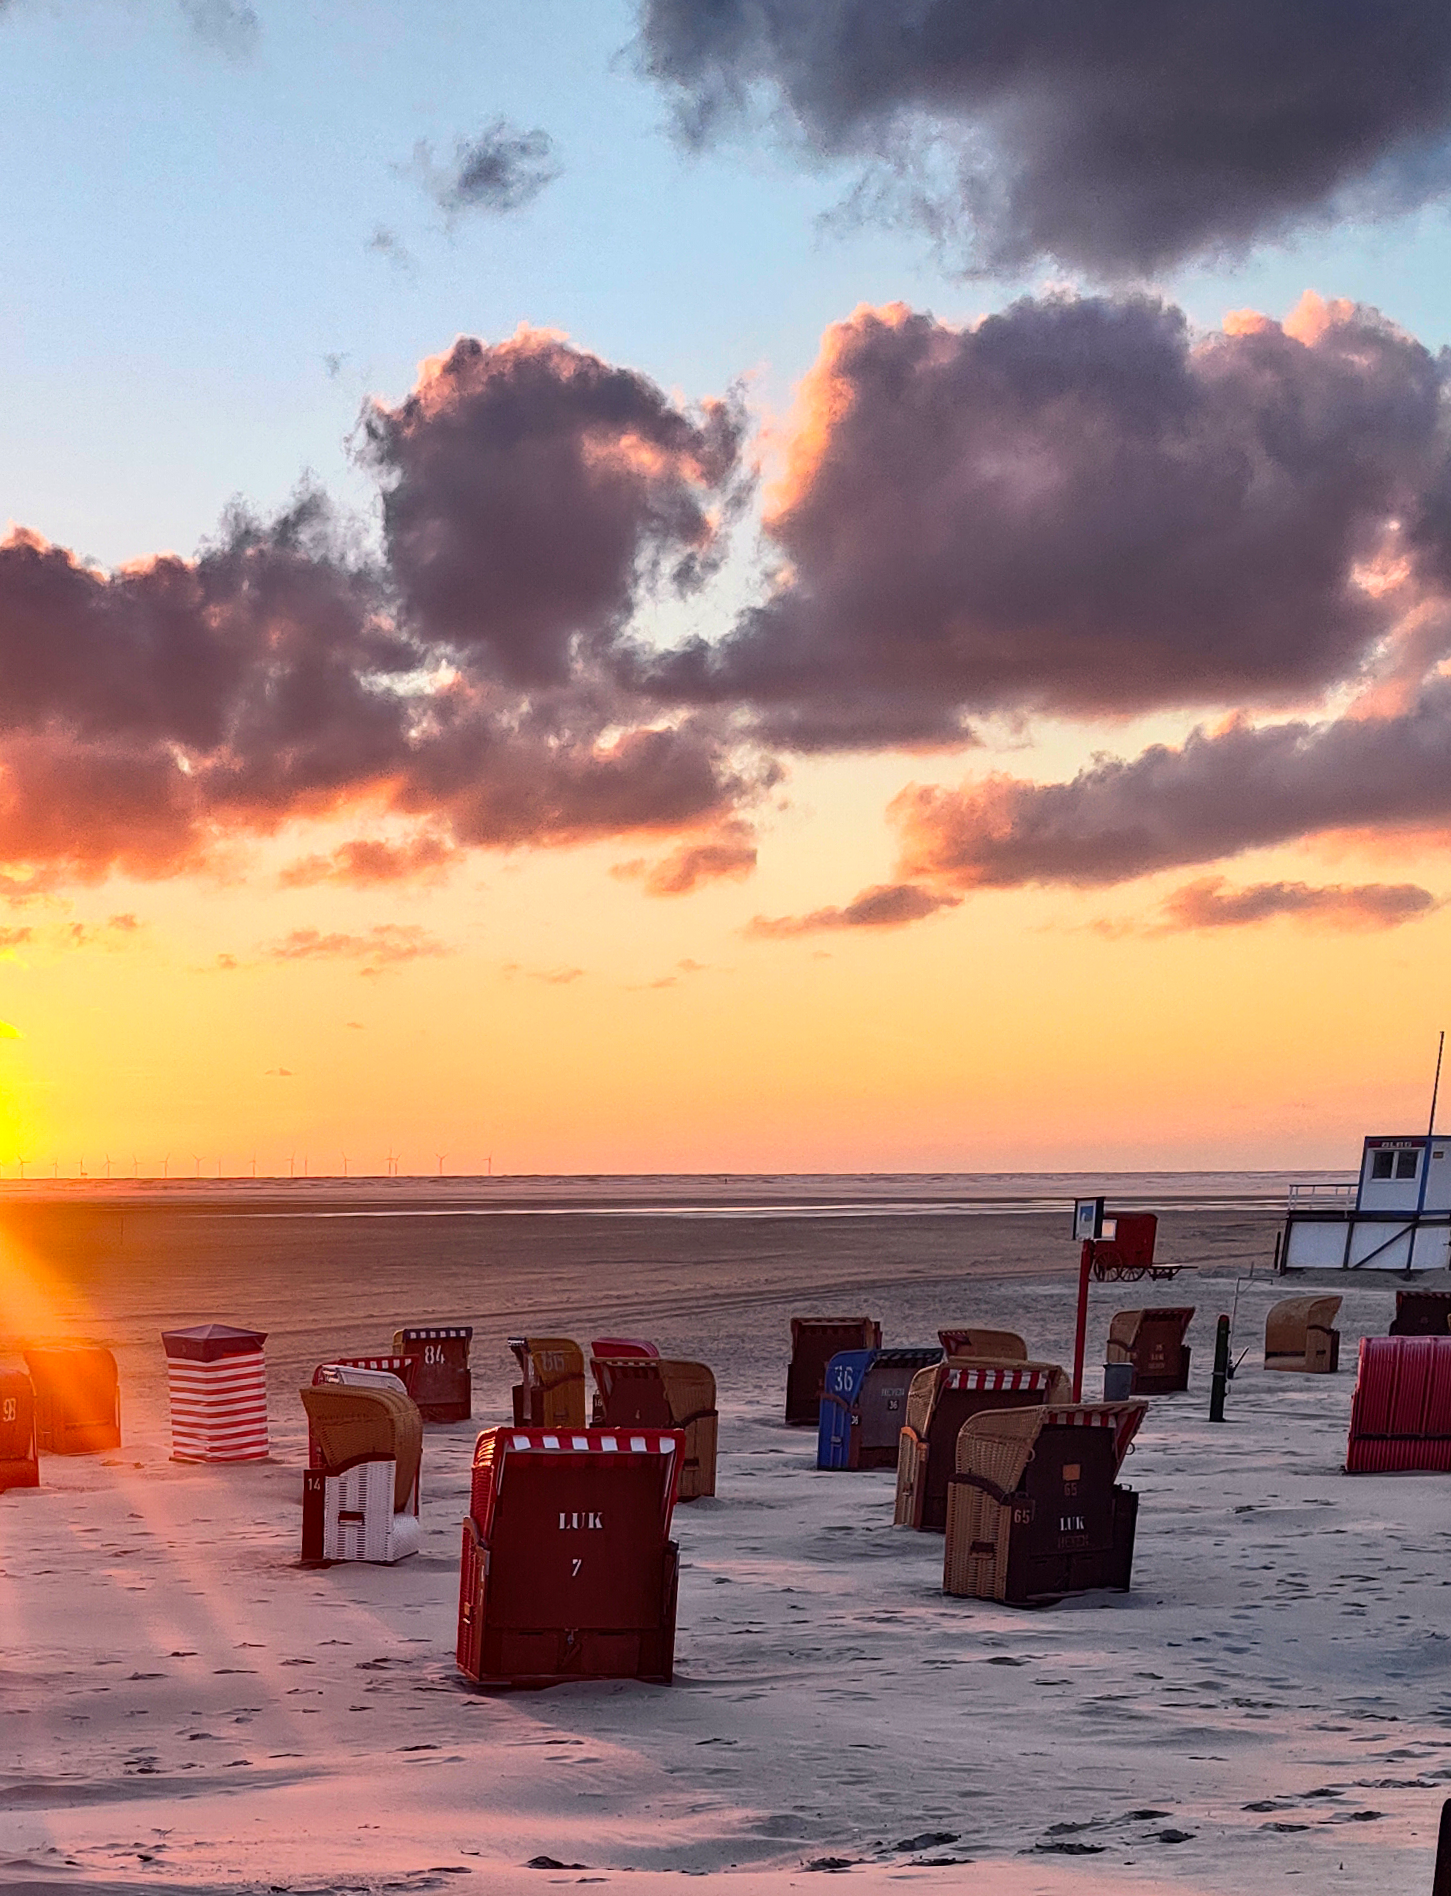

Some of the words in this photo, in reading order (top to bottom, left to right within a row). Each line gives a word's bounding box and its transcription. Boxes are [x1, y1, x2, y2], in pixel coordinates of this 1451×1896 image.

[424, 1344, 445, 1364] 84
[834, 1365, 853, 1391] 36
[889, 1400, 898, 1410] 36
[308, 1478, 321, 1490] 14
[1064, 1482, 1078, 1496] 65
[559, 1512, 603, 1529] LUK
[1014, 1509, 1030, 1524] 65
[1060, 1516, 1085, 1531] LUK
[572, 1559, 582, 1576] 7
